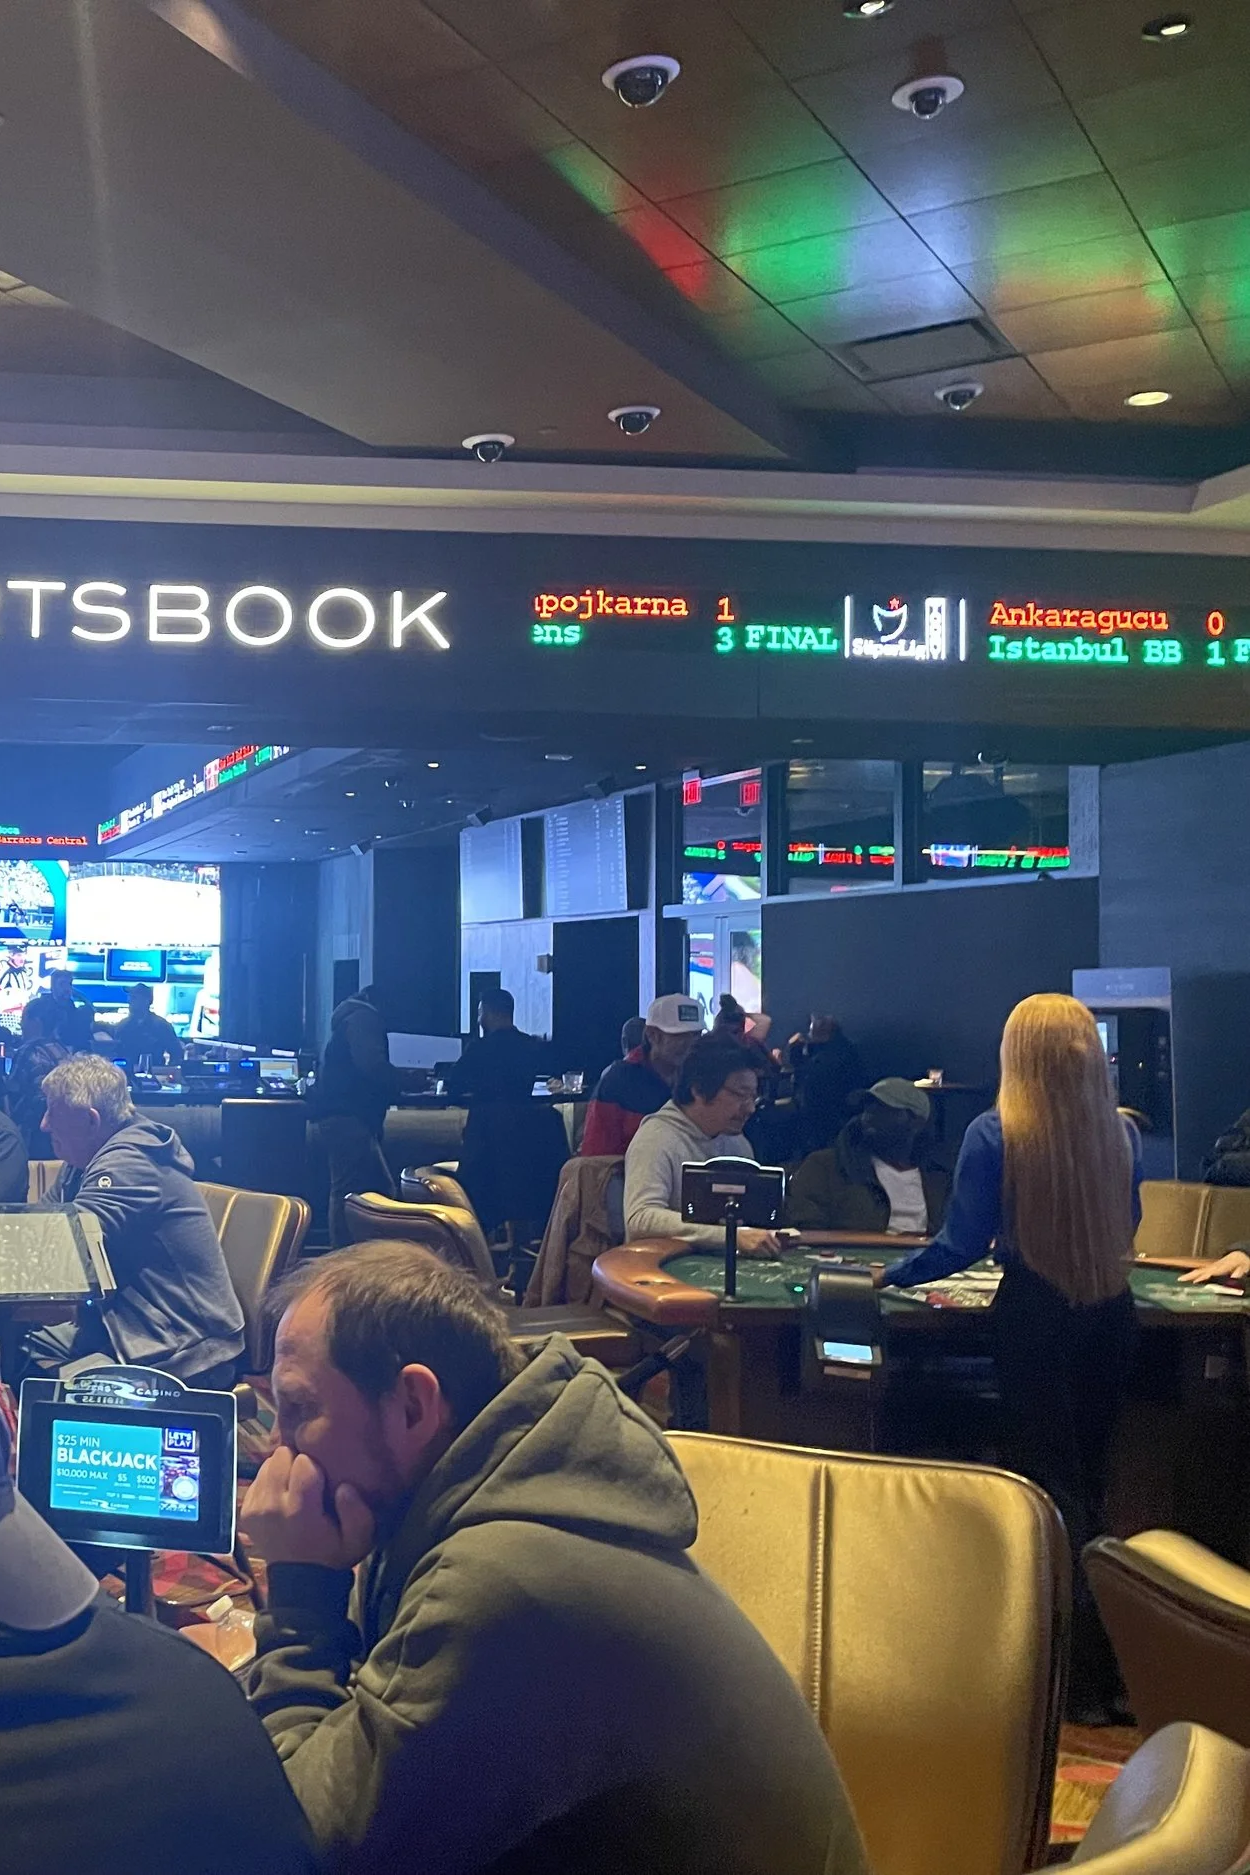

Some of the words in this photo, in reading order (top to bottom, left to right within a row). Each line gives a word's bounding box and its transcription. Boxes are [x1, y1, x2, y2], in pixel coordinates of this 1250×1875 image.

[717, 596, 734, 620] 1
[990, 602, 1168, 634] Ankaragucu
[1207, 611, 1225, 636] 0
[716, 626, 734, 651] 3
[745, 624, 837, 650] FINAL
[988, 635, 1129, 663] Istanbul
[1144, 639, 1182, 664] BB
[1207, 640, 1226, 666] 1
[47, 836, 88, 846] Central
[136, 1387, 181, 1398] CASINO
[57, 1434, 77, 1446] $25
[79, 1436, 100, 1448] MIN
[168, 1439, 192, 1448] PLAY
[57, 1446, 158, 1470] BLACKJACK
[89, 1470, 108, 1480] MAX
[136, 1474, 157, 1485] $500
